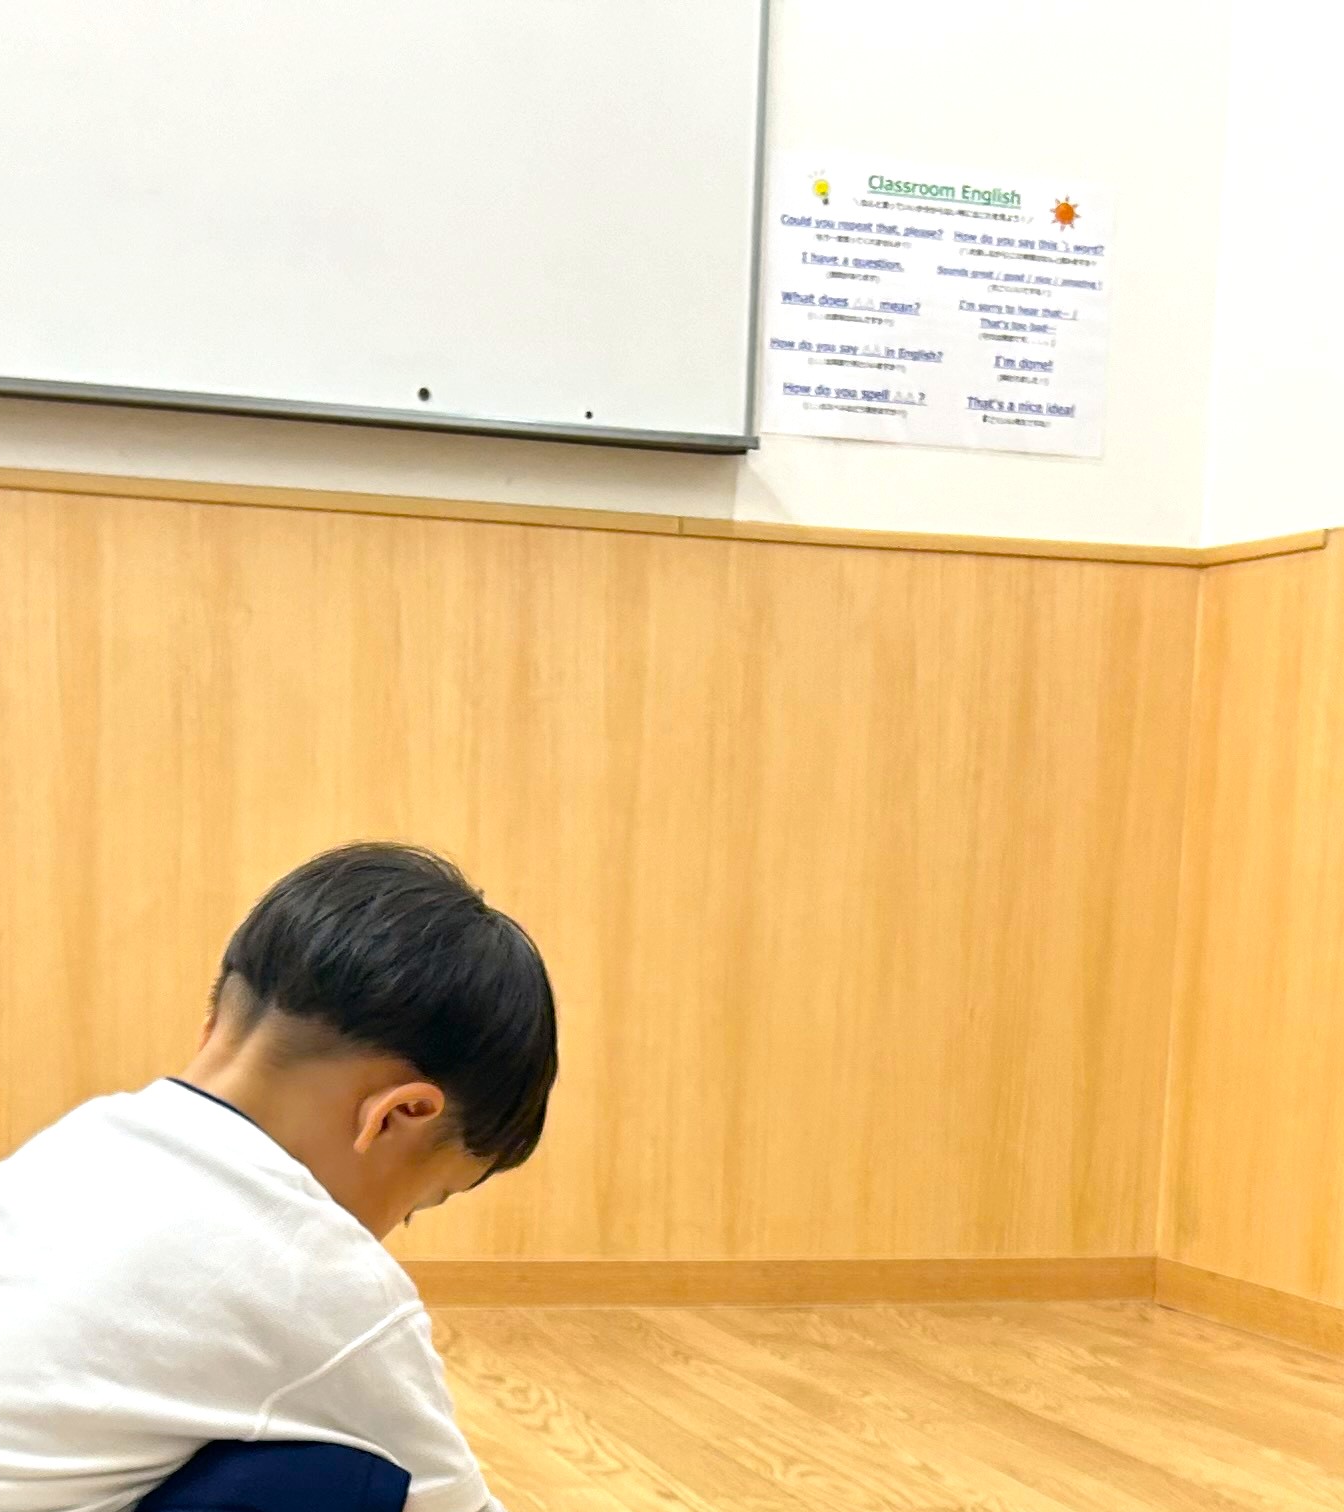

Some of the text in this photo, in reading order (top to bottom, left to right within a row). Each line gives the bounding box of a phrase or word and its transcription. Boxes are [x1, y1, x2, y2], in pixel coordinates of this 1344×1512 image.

[867, 174, 1021, 208] Classroom English
[781, 291, 921, 316] What does mean?
[783, 382, 812, 395] How
[815, 385, 832, 397] do
[834, 388, 858, 399] you
[861, 389, 891, 402] spell
[967, 396, 1005, 412] That's
